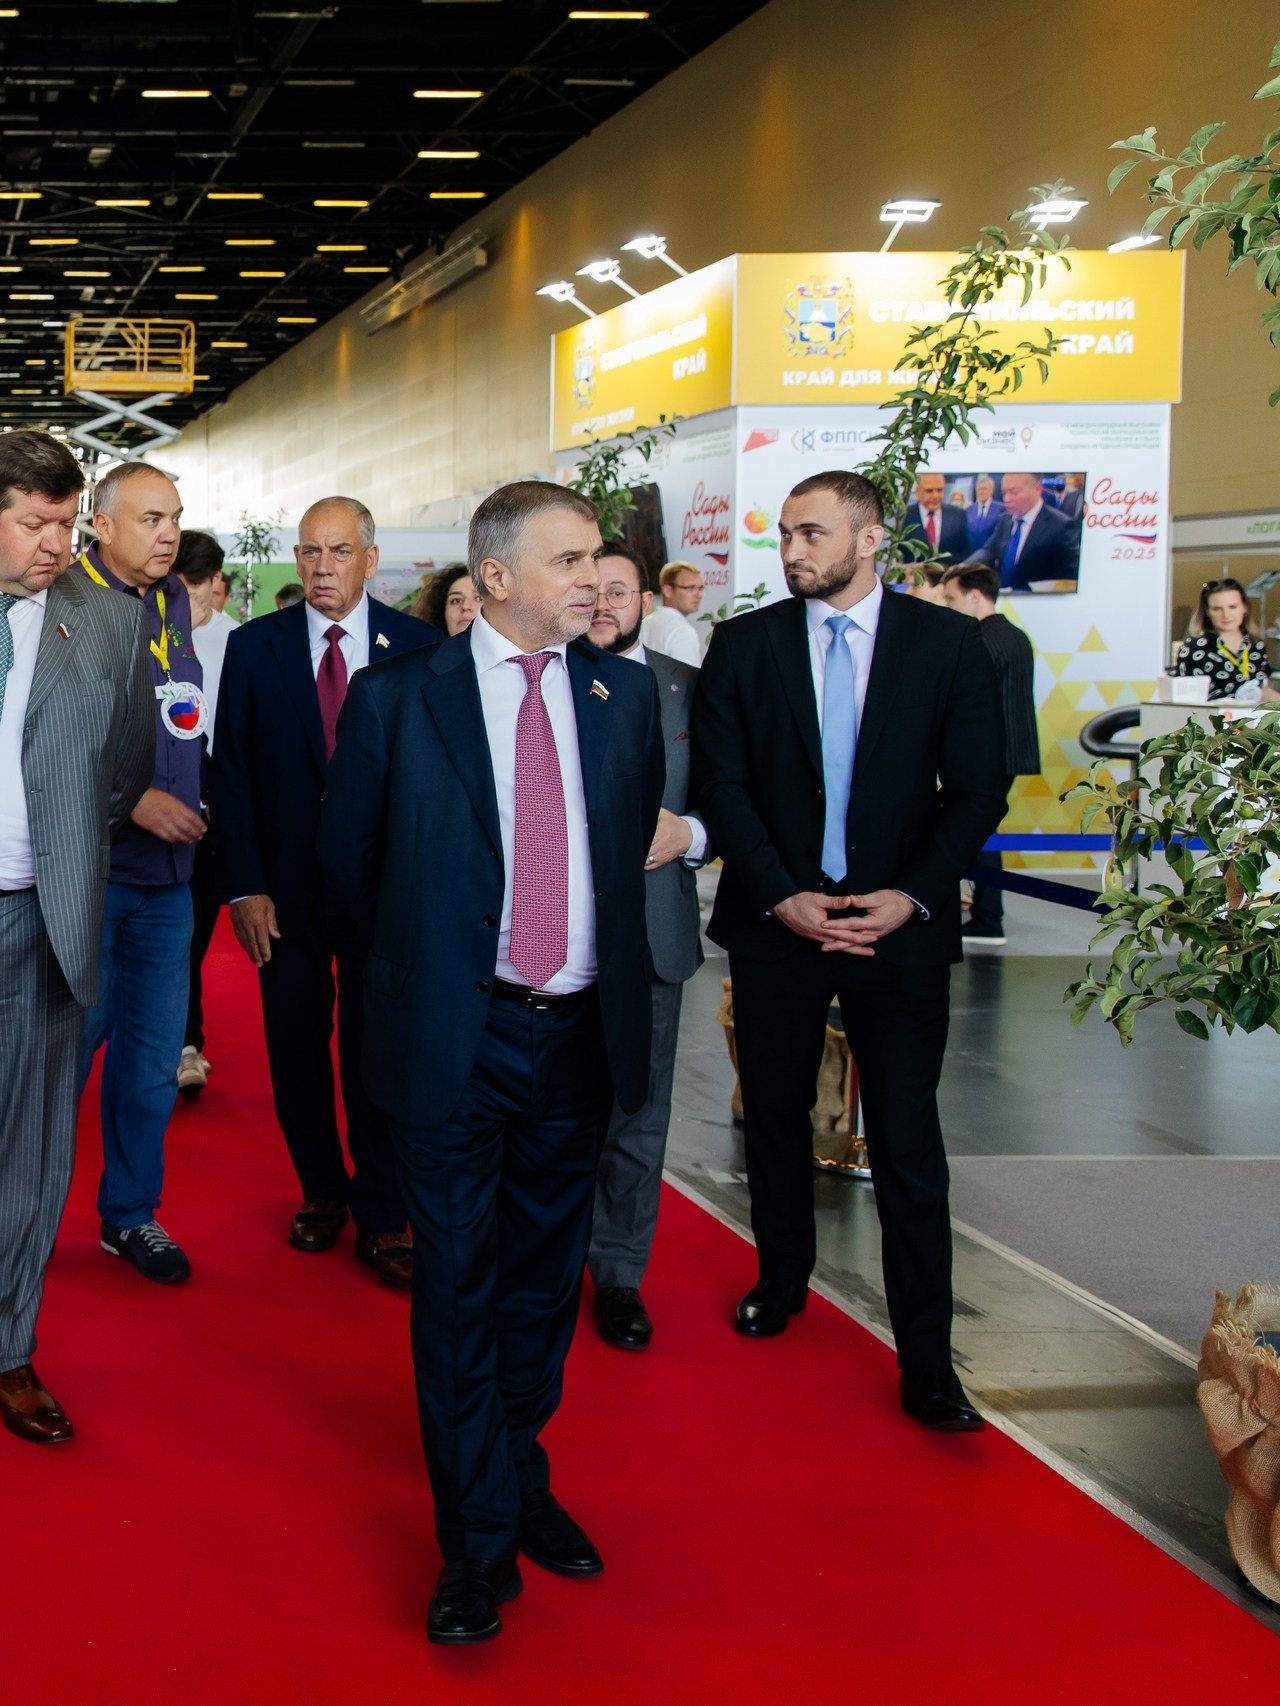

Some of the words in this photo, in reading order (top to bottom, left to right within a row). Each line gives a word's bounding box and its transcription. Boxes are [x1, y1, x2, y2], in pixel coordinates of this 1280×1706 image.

[1061, 331, 1135, 355] КРАЙ
[782, 367, 835, 385] КРАЙ
[839, 369, 882, 387] ДЛЯ
[691, 481, 730, 522] Сады
[1091, 477, 1159, 512] Сады
[680, 511, 730, 549] России
[1111, 547, 1157, 560] 2025
